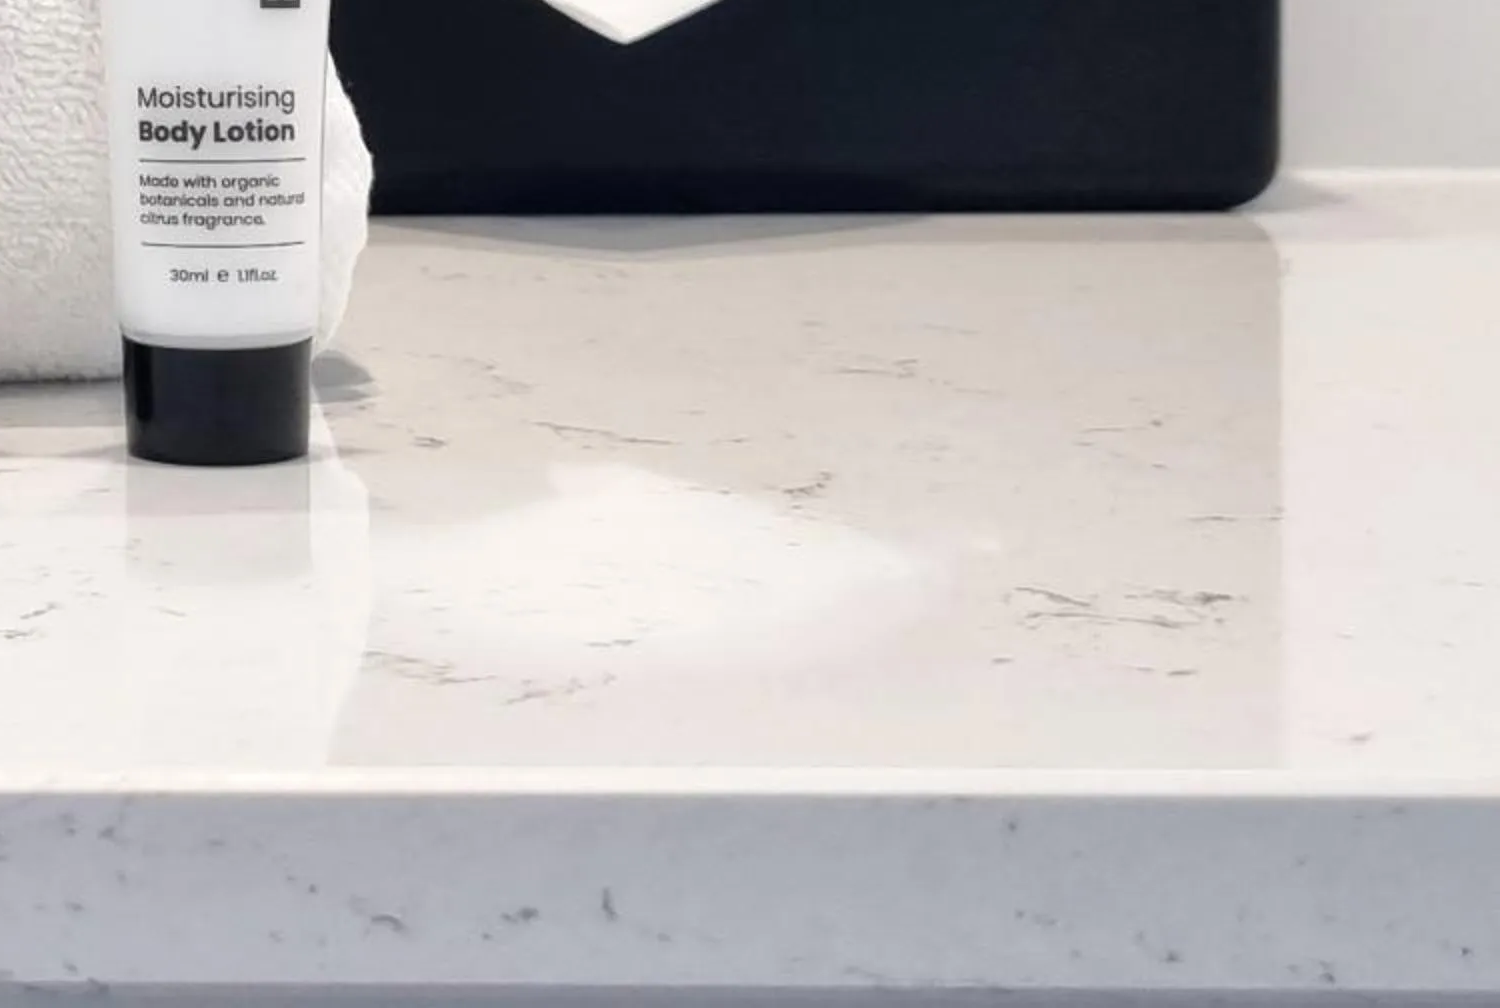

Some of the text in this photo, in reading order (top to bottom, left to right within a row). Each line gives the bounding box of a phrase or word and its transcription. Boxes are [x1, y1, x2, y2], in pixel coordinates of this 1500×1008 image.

[137, 85, 295, 114] Moisturising
[139, 119, 295, 150] Body Lotion
[184, 176, 216, 187] with
[221, 174, 280, 192] organic
[140, 193, 219, 207] botanicals
[224, 193, 254, 206] and
[170, 269, 208, 282] 30ml
